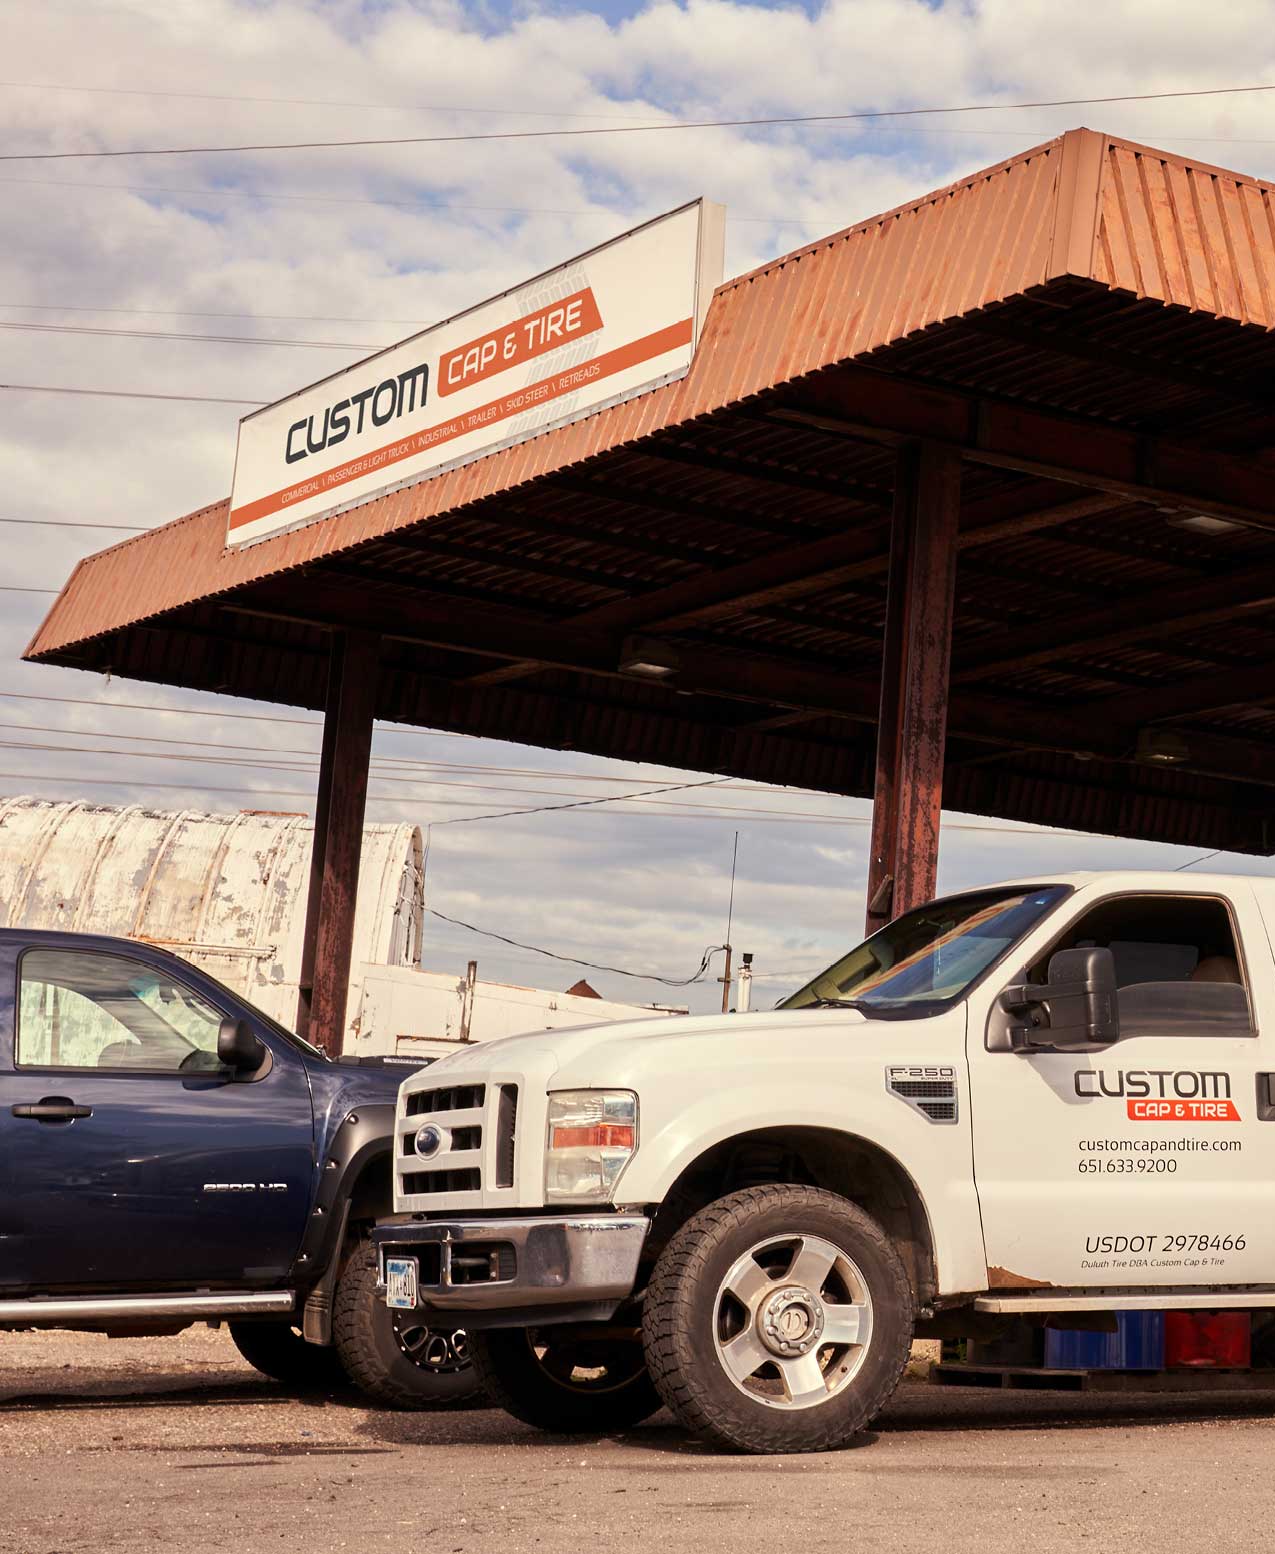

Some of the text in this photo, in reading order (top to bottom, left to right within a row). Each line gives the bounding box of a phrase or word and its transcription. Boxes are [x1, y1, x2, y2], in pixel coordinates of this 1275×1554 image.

[285, 299, 583, 464] CUSTOM CAP & TIRE
[281, 480, 320, 504] COMMERCIAL
[327, 462, 363, 483] PASSENGER
[368, 451, 387, 469] LIGHT
[387, 442, 410, 458] TRUCK
[417, 423, 458, 448] INDUSTRIAL
[467, 406, 497, 427] TRAILER
[506, 397, 524, 411] SKID
[525, 385, 549, 403] STEER
[558, 363, 601, 388] RETREADS
[890, 1068, 953, 1077] F-250
[1074, 1070, 1231, 1098] CUSTOM
[1134, 1103, 1228, 1117] CAP & TIRE
[1078, 1137, 1242, 1154] customcapandtire.com
[1078, 1159, 1177, 1173] 651.633.9200
[203, 1183, 288, 1192] 2500 HD
[1085, 1234, 1246, 1253] USDOT 2978466
[1081, 1260, 1109, 1268] Duluth
[1112, 1259, 1127, 1267] Tire
[1129, 1259, 1148, 1267] DBA
[1150, 1258, 1182, 1267] Custom
[1184, 1258, 1200, 1267] Cap
[1210, 1257, 1225, 1265] Tire
